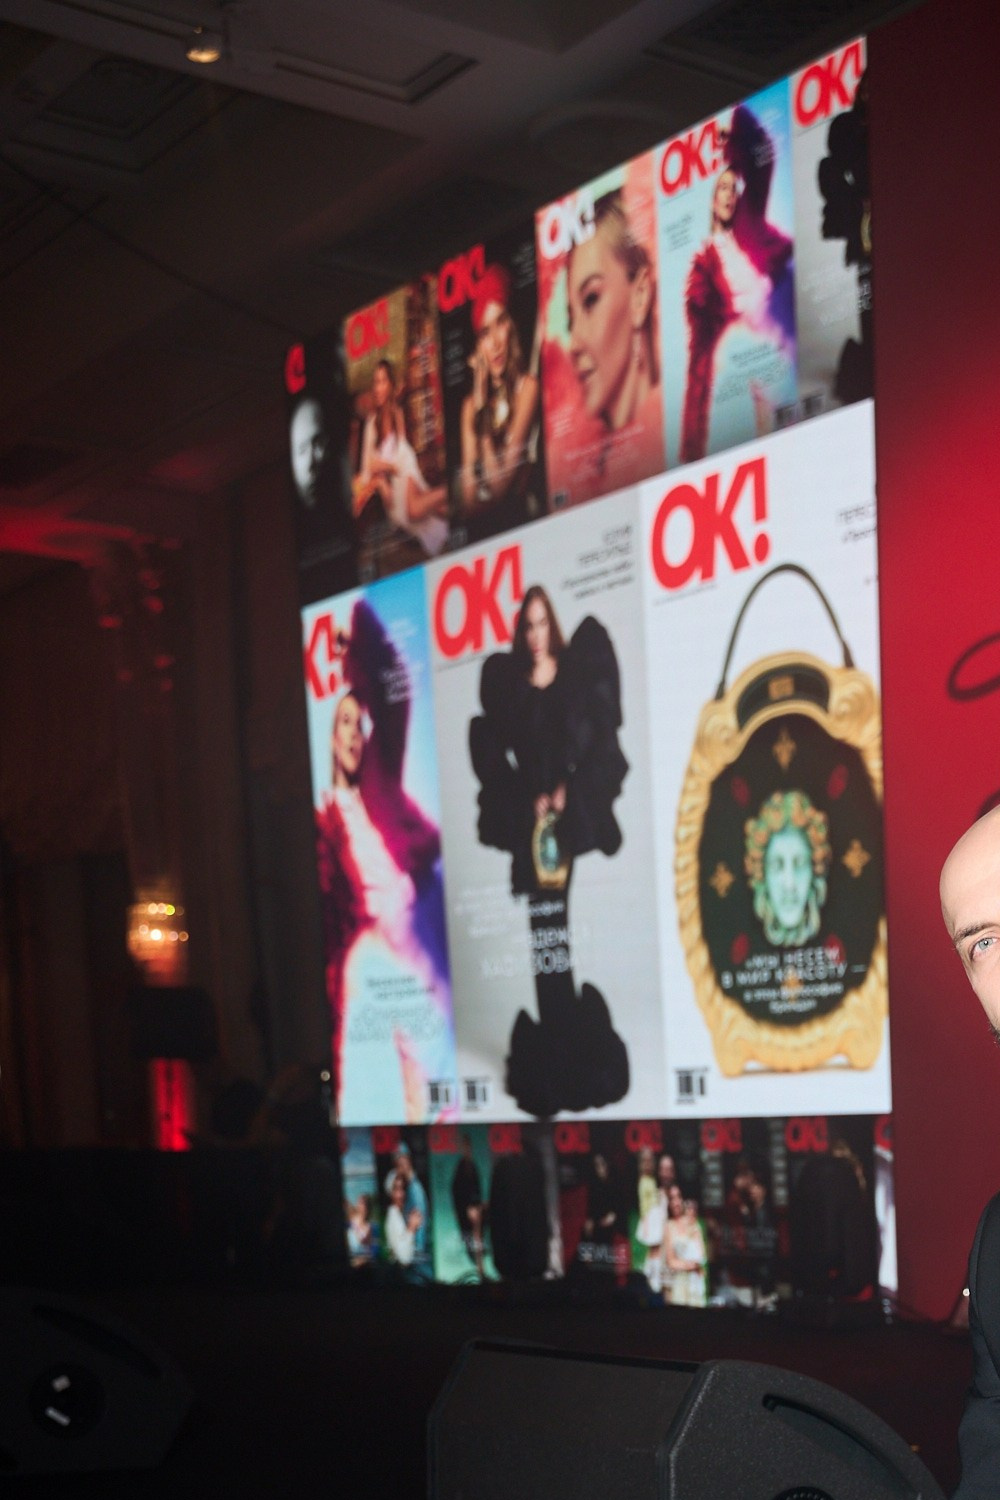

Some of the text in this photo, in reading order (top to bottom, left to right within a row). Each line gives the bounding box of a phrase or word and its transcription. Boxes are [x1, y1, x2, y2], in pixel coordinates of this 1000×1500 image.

[661, 121, 718, 196] OK!
[652, 457, 769, 588] OK!
[433, 545, 524, 659] OK!
[304, 614, 337, 699] K!
